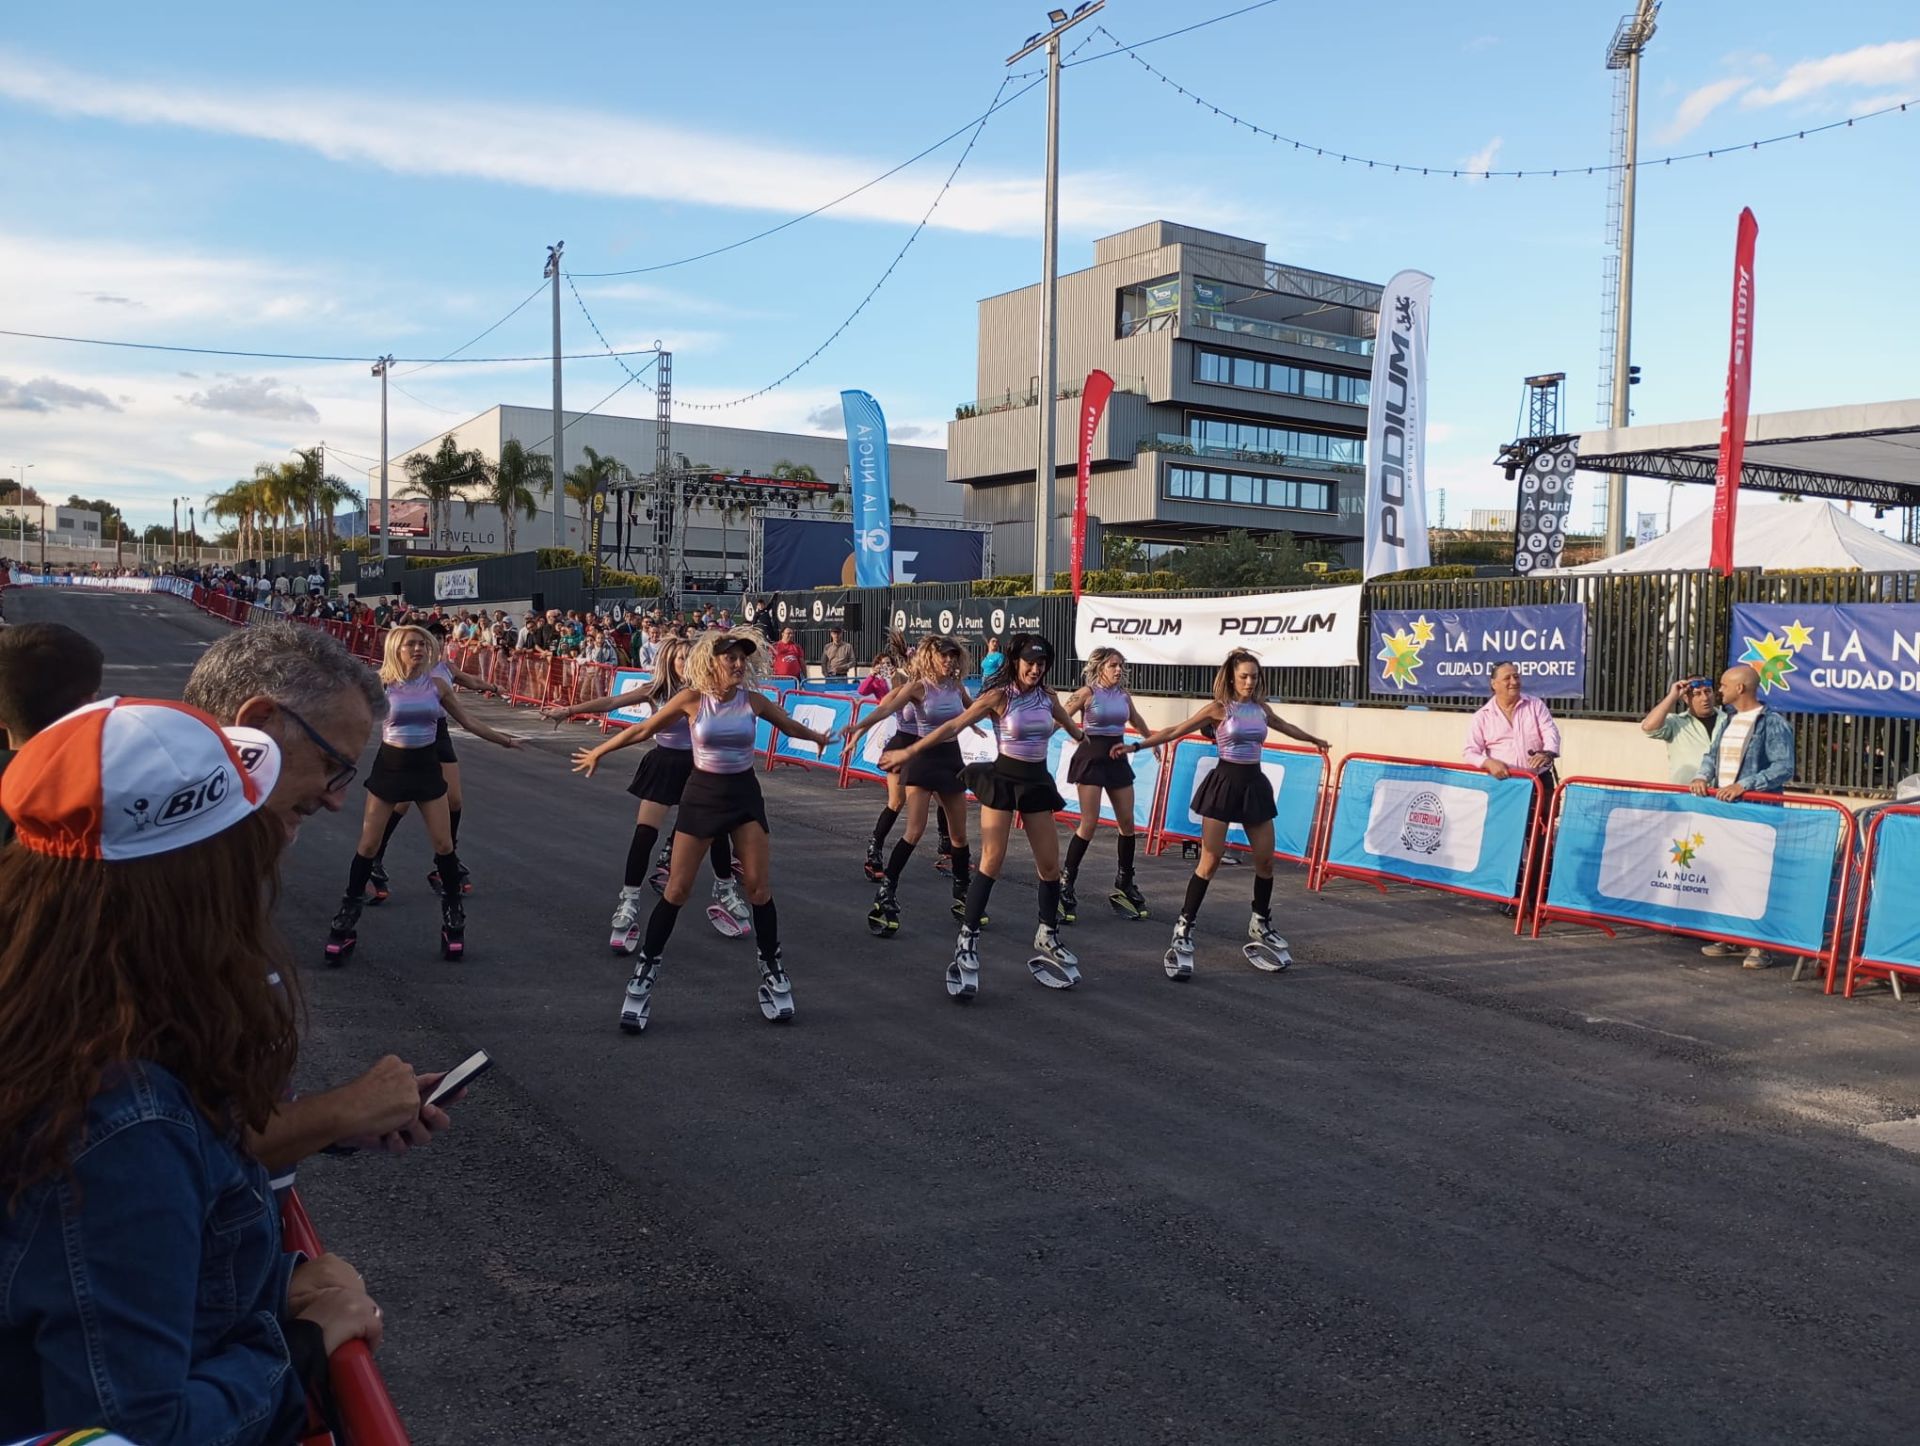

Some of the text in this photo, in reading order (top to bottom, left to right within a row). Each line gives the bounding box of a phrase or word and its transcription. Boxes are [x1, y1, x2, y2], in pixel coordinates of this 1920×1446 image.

[1382, 330, 1410, 548] PODIUM
[1524, 497, 1569, 512] À Punt
[909, 615, 916, 628] À
[916, 618, 932, 629] Punt
[957, 615, 963, 628] À
[965, 617, 983, 629] Punt
[1010, 614, 1017, 628] À
[1019, 616, 1040, 628] Punt
[1091, 617, 1182, 635] PODIUM
[1219, 612, 1336, 636] PODIUM
[1445, 631, 1468, 652] LA
[1822, 629, 1867, 662] LA
[1436, 661, 1483, 676] CIUDAD
[1810, 668, 1894, 690] CIUDAD
[162, 771, 225, 819] BIC
[1657, 870, 1668, 879] LA
